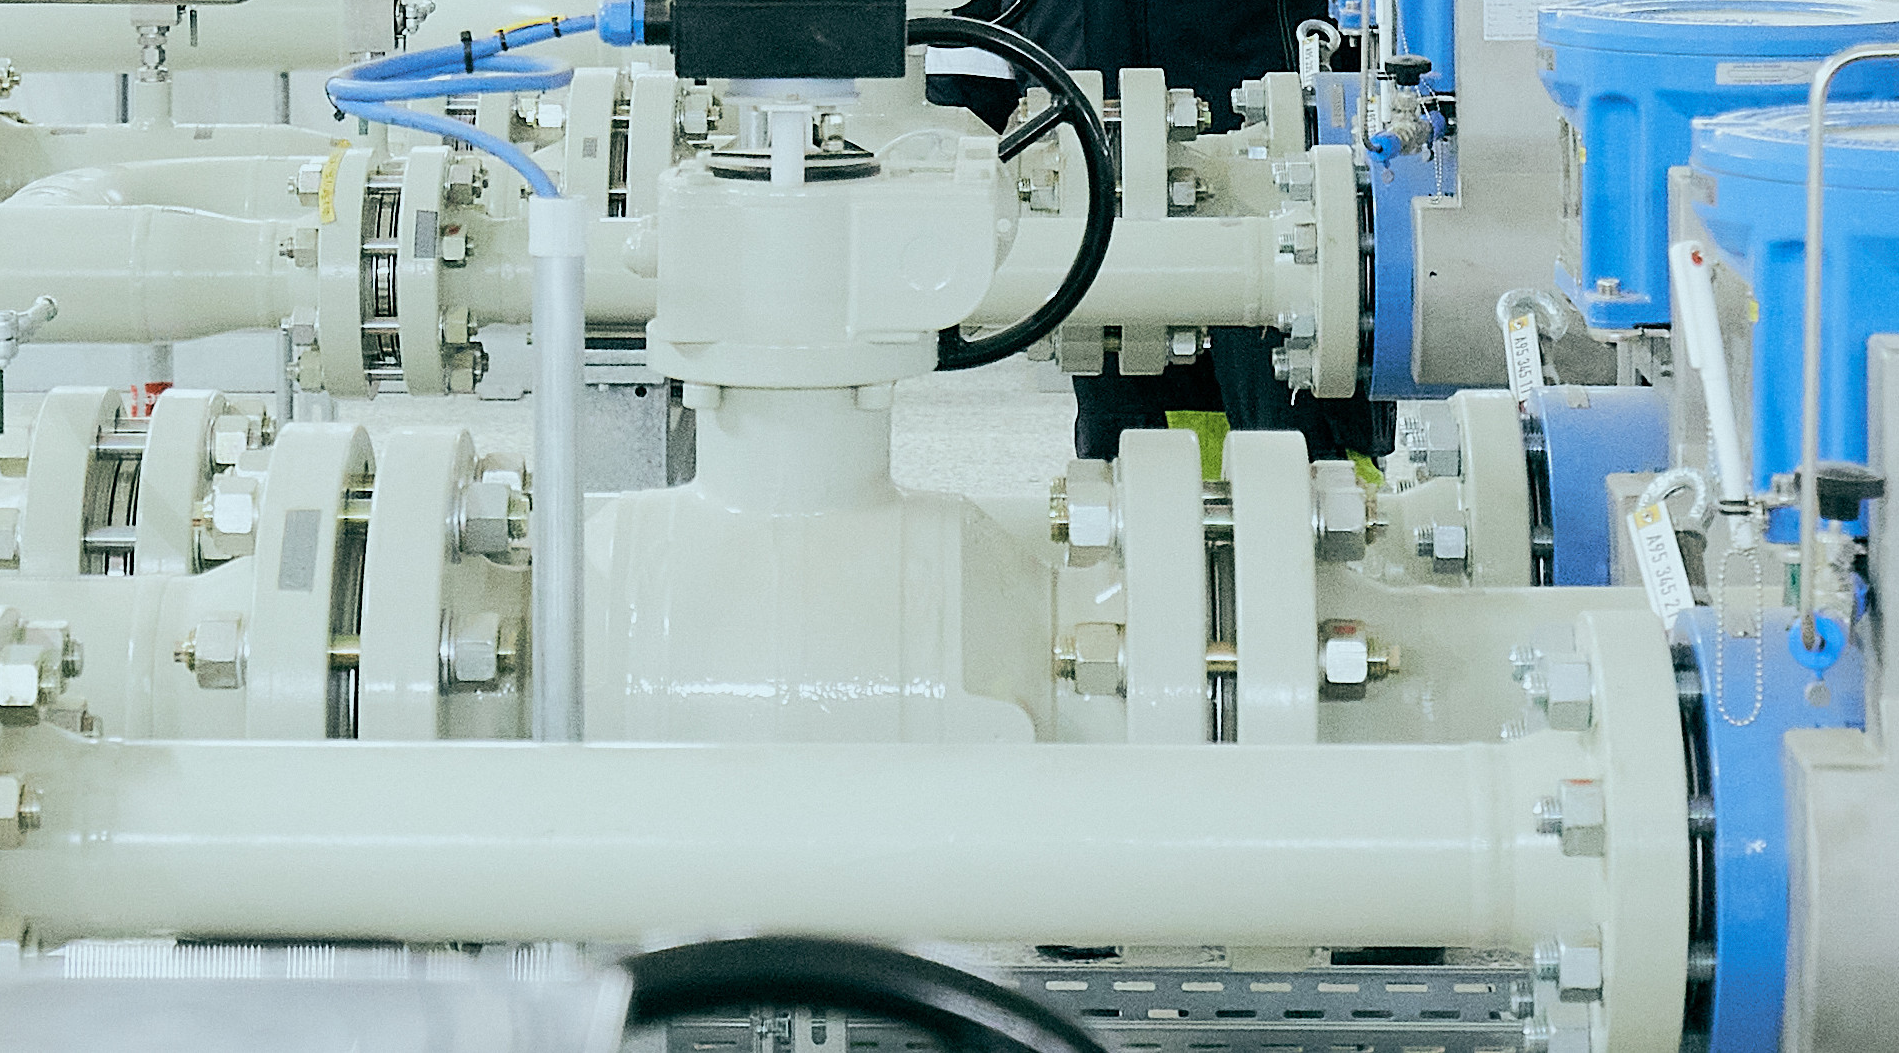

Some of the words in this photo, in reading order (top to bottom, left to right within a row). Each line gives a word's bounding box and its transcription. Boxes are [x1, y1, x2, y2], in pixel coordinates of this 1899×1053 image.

[1513, 336, 1530, 357] A95
[1517, 357, 1533, 379] 345
[1646, 534, 1668, 563] A95
[1656, 566, 1678, 595] 345
